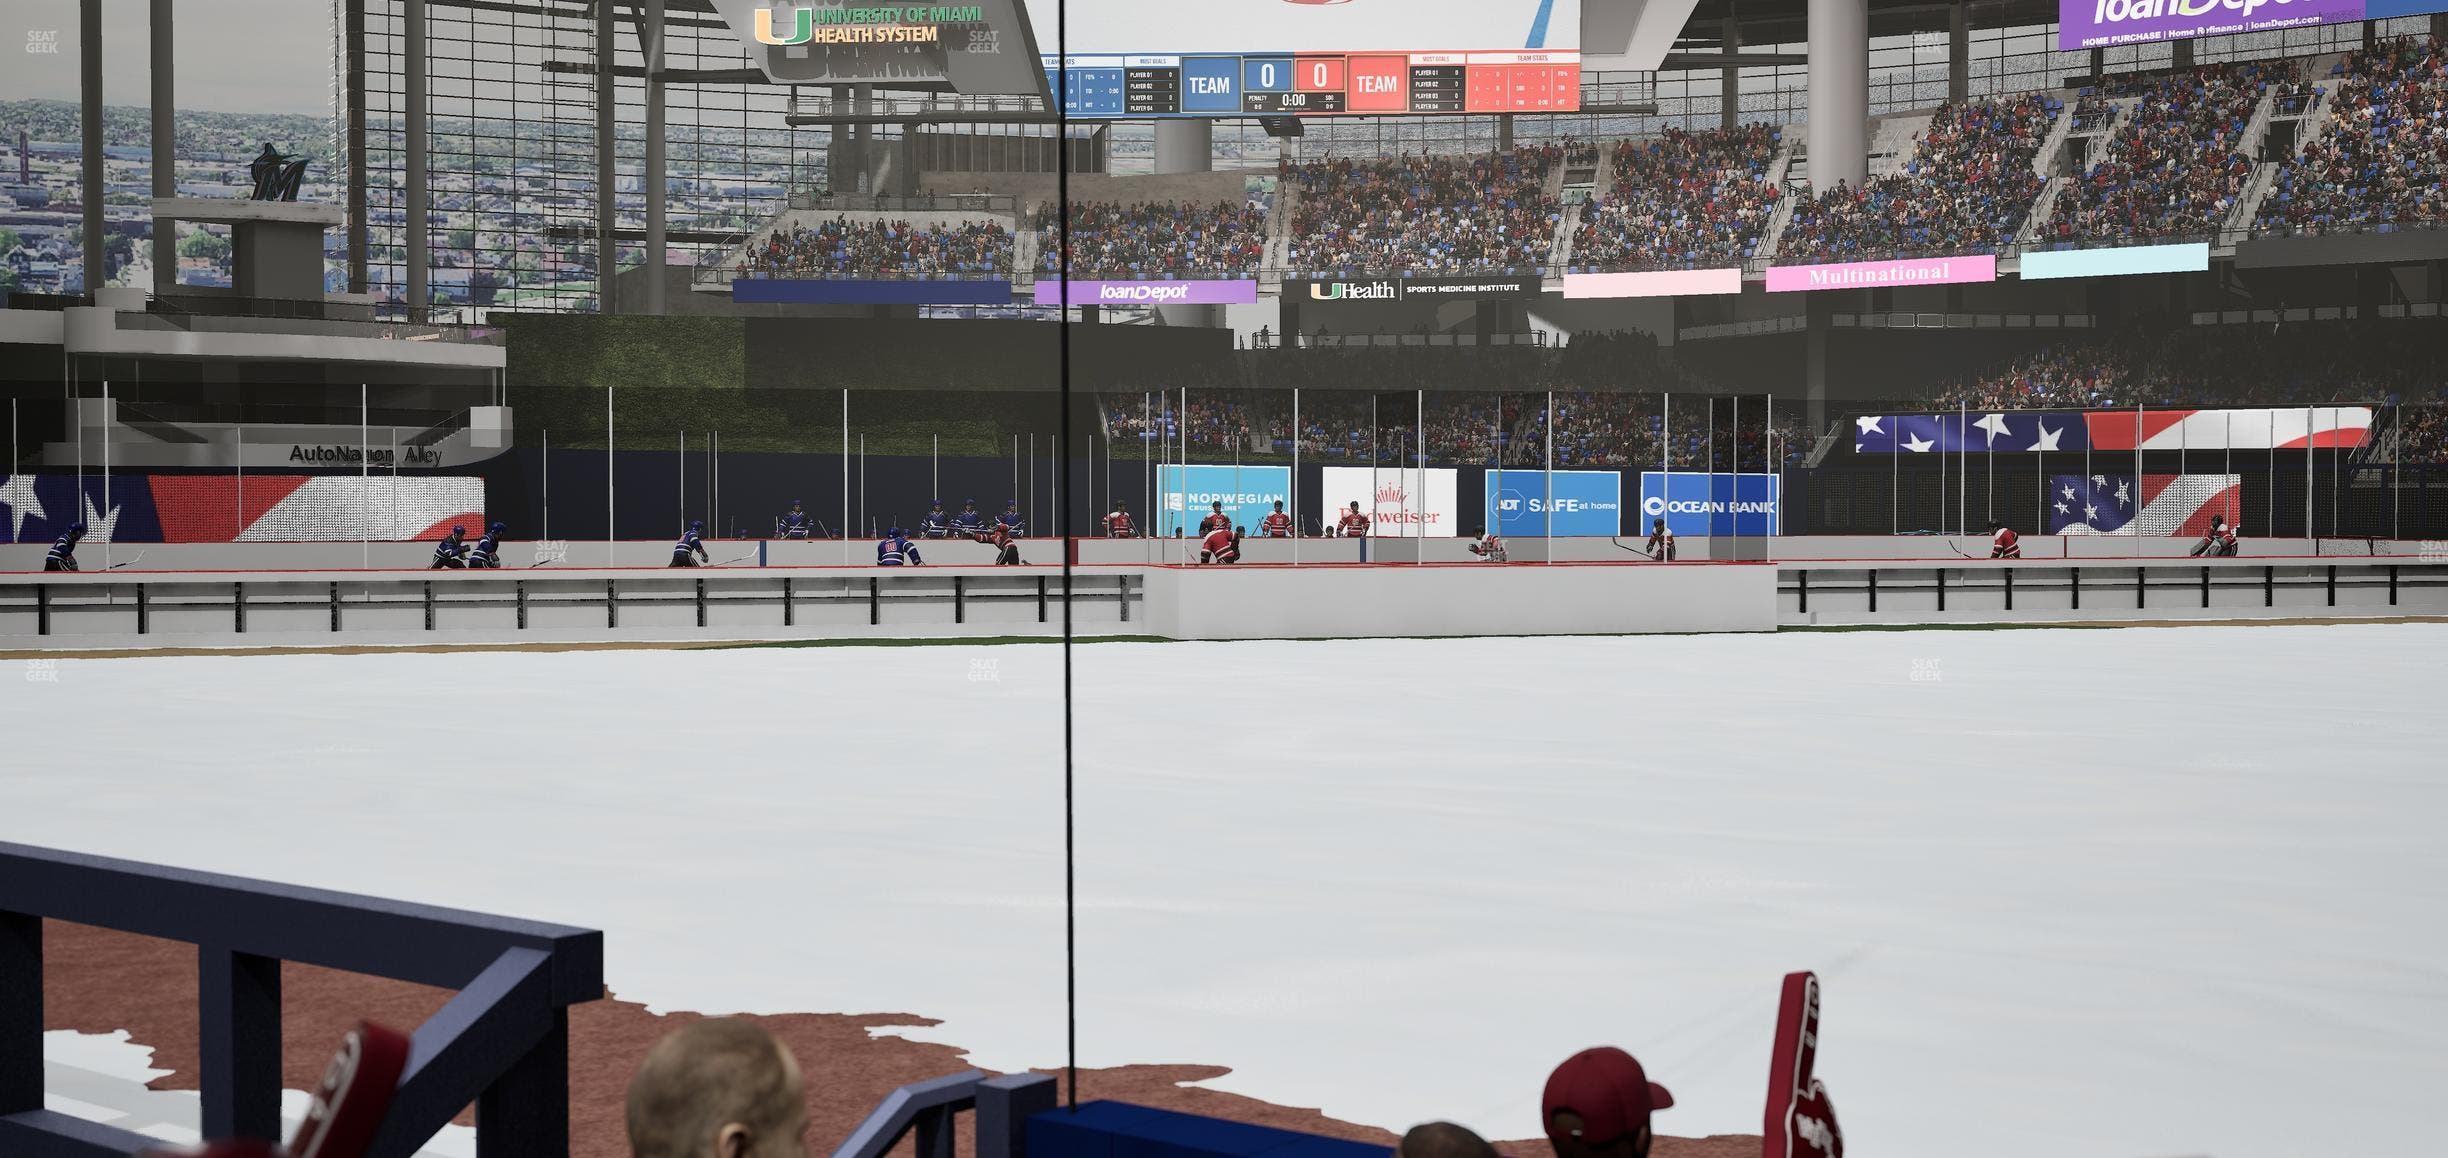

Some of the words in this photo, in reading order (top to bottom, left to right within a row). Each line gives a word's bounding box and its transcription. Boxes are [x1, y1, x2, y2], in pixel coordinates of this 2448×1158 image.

[815, 7, 904, 25] UNIVERSITY
[906, 7, 928, 23] OF
[930, 7, 982, 23] MIAMI
[815, 28, 872, 44] HEALTH
[876, 26, 937, 42] SYSTEM
[2082, 36, 2109, 47] HOME
[2111, 31, 2161, 44] PURCHASE
[2168, 28, 2194, 38] Home
[2251, 16, 2322, 29] loanDepot.com
[1261, 63, 1275, 88] 0
[1313, 63, 1327, 88] 0
[1356, 75, 1397, 93] TEAM
[1189, 77, 1230, 94] TEAM
[1282, 93, 1306, 106] 0:00
[1809, 262, 1950, 285] Multinational
[1100, 284, 1188, 302] loanDepot
[1406, 285, 1437, 293] SPORTS
[1438, 285, 1477, 293] MEDICINE
[1478, 284, 1520, 292] INSTITUTE
[289, 445, 394, 462] AutoNaion
[1188, 493, 1283, 504] NORWEGIAN
[1496, 499, 1520, 511] ADT
[1529, 499, 1579, 512] SAFE
[1579, 501, 1588, 510] at
[1591, 501, 1617, 510] home
[1668, 500, 1724, 513] OCEAN
[1729, 501, 1776, 513] BANK
